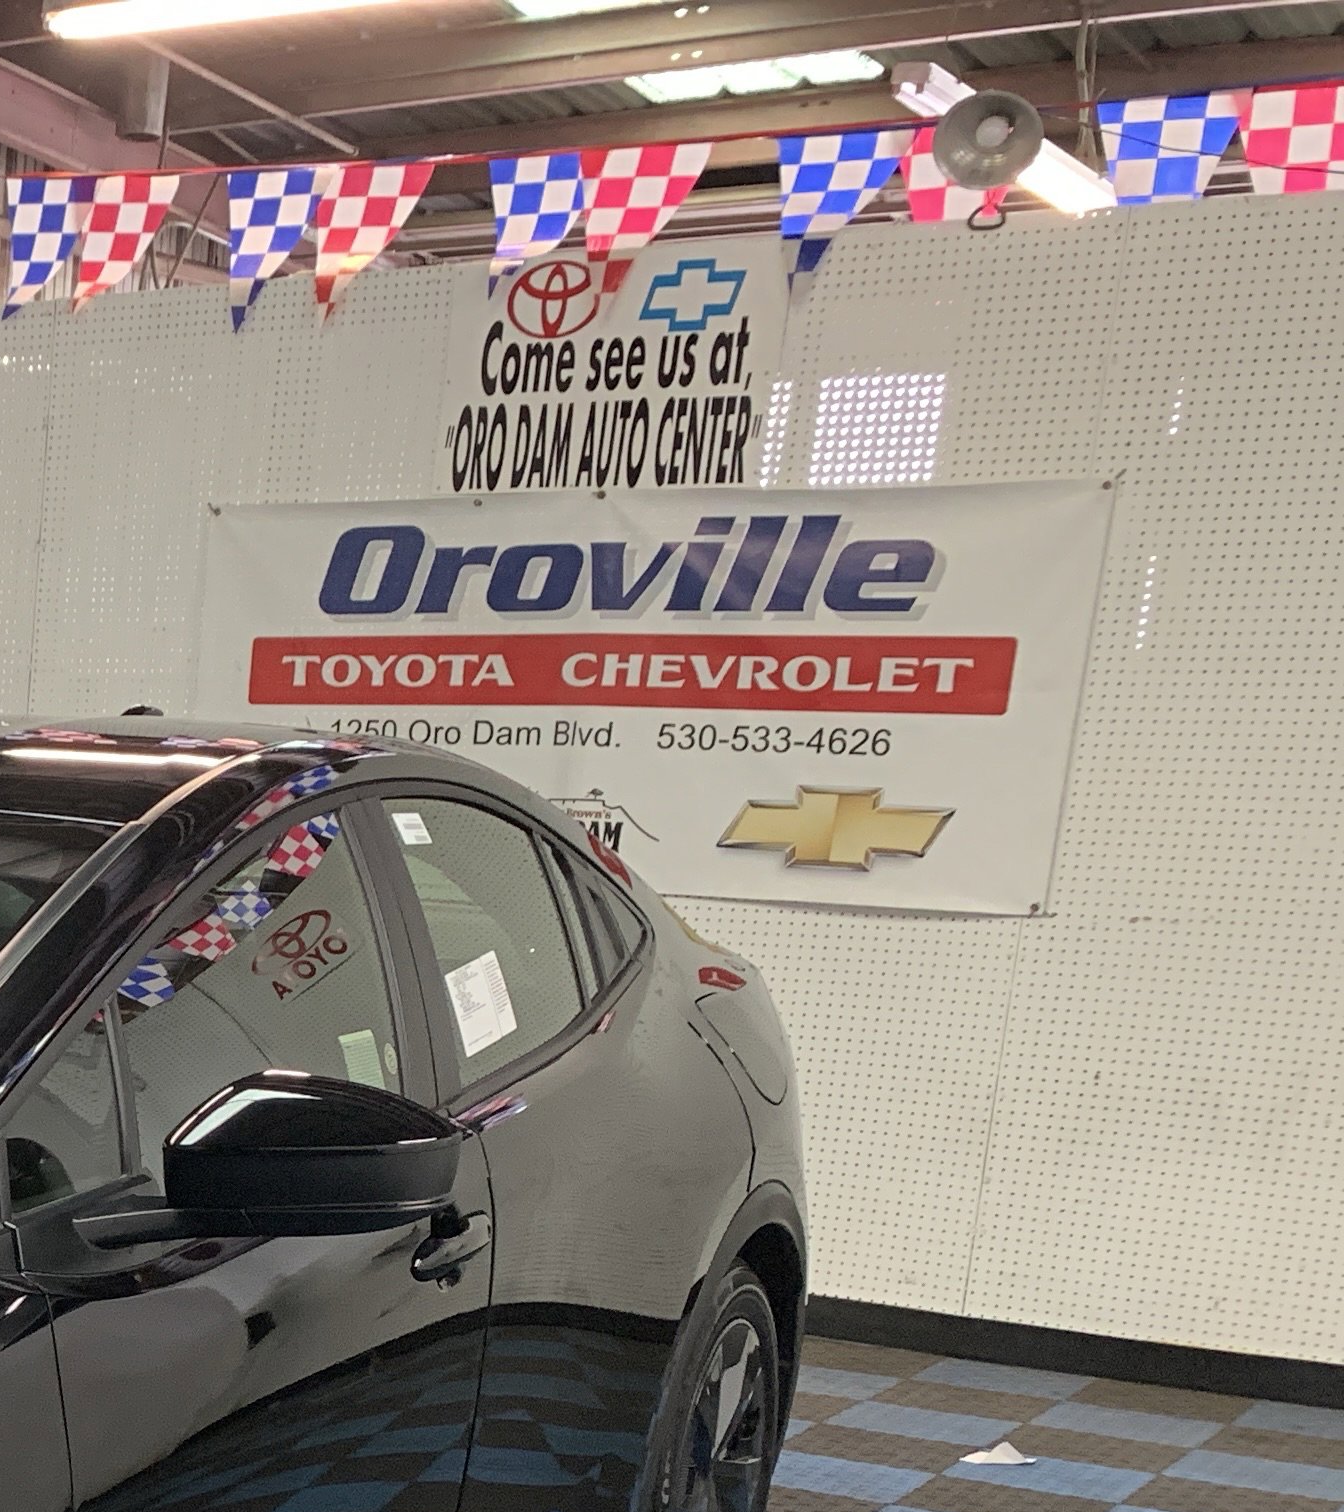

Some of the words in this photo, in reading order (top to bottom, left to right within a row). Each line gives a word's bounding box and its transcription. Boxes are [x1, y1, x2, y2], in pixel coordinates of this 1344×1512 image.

[481, 320, 575, 396] Come
[585, 335, 646, 392] see
[657, 332, 699, 389] us
[710, 316, 753, 391] at,
[444, 403, 507, 492] "ORO
[510, 402, 574, 490] DAM
[575, 397, 650, 488] AUTO
[654, 395, 763, 487] CENTER"
[318, 514, 936, 615] Oroville
[281, 653, 515, 688] TOYOTA
[561, 652, 975, 693] CHEVROLET
[409, 719, 461, 745] Oro
[474, 719, 541, 746] Dam
[553, 720, 621, 748] Blvd.
[657, 723, 892, 757] 530-533-4626
[579, 820, 623, 853] AM
